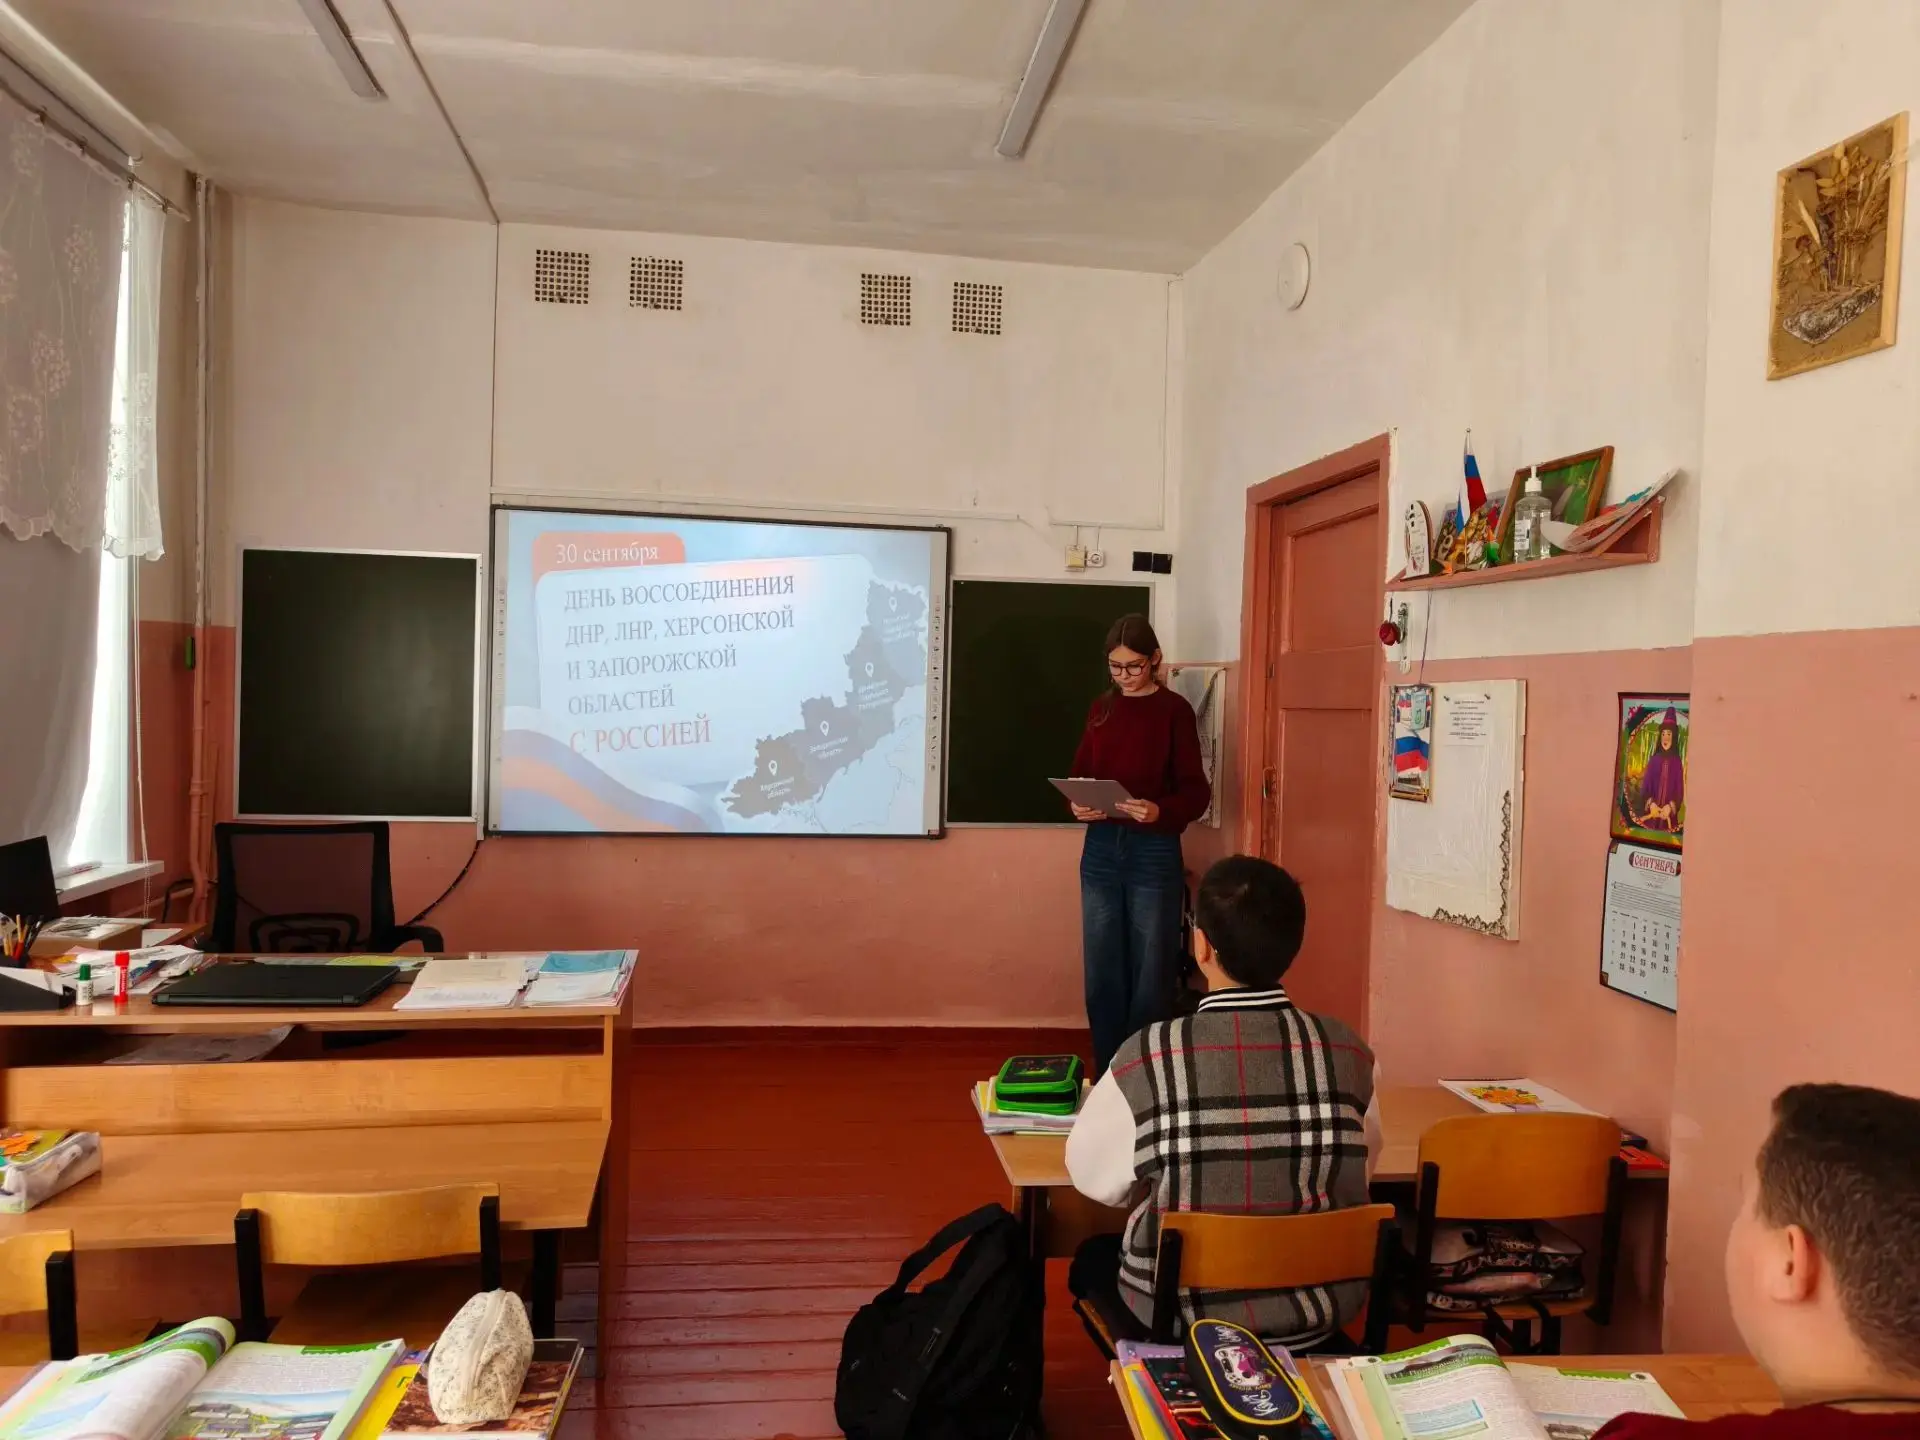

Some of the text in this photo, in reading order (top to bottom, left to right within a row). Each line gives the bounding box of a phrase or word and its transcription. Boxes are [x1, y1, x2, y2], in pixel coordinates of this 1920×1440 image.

[556, 541, 659, 565] 30 сентября
[564, 575, 795, 612] ДЕНЬ ВОССОЕДИНЕНИЯ
[565, 604, 795, 648] ДНР, ЛНР, ХЕРСОНСКОЙ
[566, 643, 737, 681] И ЗАПОРОЖСКОЙ
[568, 683, 676, 716] ОБЛАСТЕЙ
[570, 713, 712, 754] С РОССИЕЙ
[1634, 854, 1675, 874] СЕНТЯБРЬ
